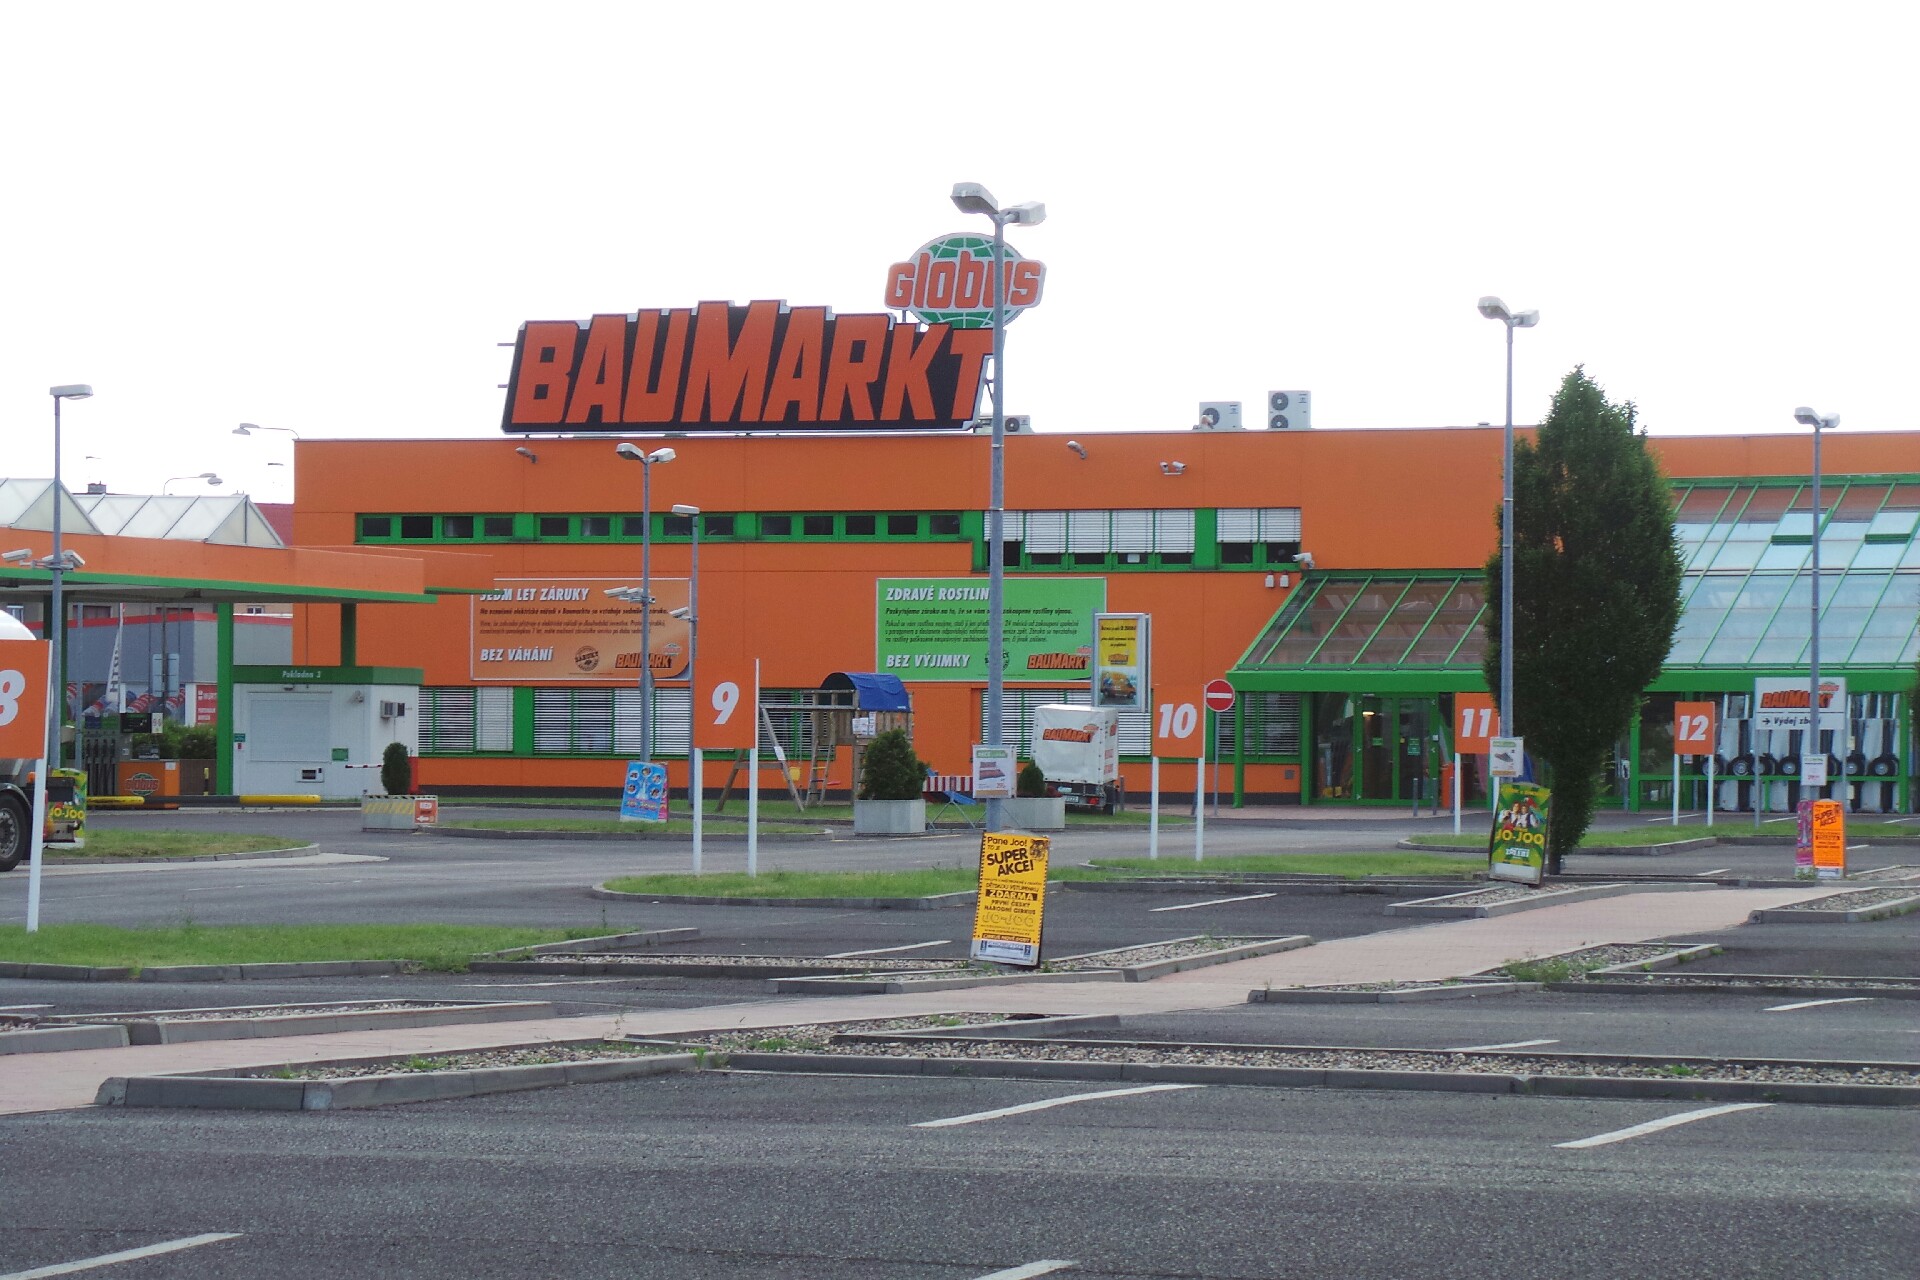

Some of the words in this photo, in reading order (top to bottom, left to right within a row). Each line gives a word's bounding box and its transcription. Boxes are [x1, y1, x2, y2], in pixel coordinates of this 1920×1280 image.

[886, 250, 1041, 309] Globus
[510, 300, 997, 424] BAUMARKT
[516, 588, 537, 601] LET
[540, 585, 589, 601] ZÁRUKY
[886, 584, 934, 602] ZDRAVÉ
[938, 587, 990, 601] ROSTLIN
[480, 648, 504, 661] BEZ
[507, 646, 554, 661] VÁHÁNÍ
[886, 654, 911, 667] BEZ
[914, 652, 971, 668] VÝJIMKY
[1027, 652, 1092, 669] BAUMARKT
[711, 681, 740, 725] 9
[1761, 691, 1834, 708] BAUMAKT
[1158, 703, 1198, 739] 10
[1461, 708, 1492, 738] 11
[1678, 715, 1710, 741] 12
[1773, 716, 1798, 727] Výdej
[987, 836, 1008, 846] Pane
[1010, 838, 1028, 847] Joo!
[1495, 828, 1545, 845] JO-JOO
[986, 847, 1029, 866] SUPER
[997, 860, 1034, 877] AKCE!
[989, 889, 1034, 902] ZDARMA
